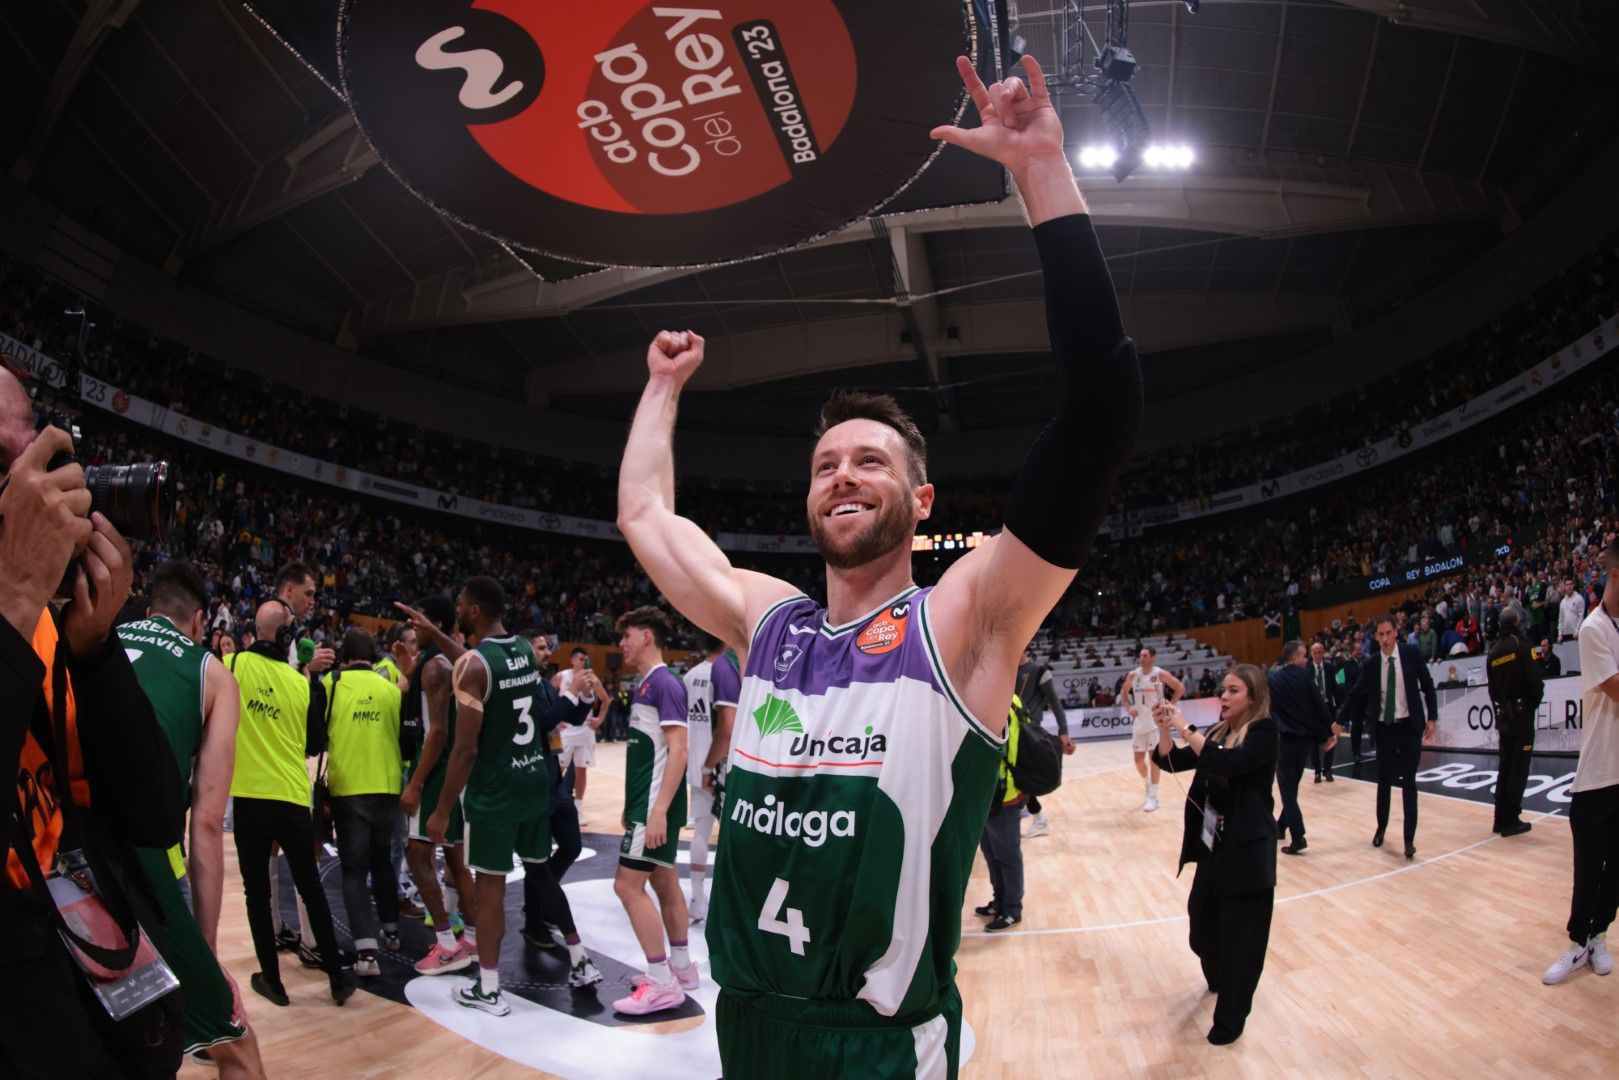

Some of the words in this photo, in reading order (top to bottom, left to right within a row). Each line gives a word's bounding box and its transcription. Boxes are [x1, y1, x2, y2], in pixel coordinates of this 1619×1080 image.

[652, 7, 742, 105] Rey
[577, 99, 637, 163] acb
[594, 42, 700, 176] Copa
[761, 60, 816, 163] Badalona
[693, 111, 741, 156] del
[1369, 577, 1391, 590] COPA
[1406, 568, 1420, 580] REY
[1424, 556, 1463, 576] BADALON
[866, 625, 896, 636] Copa
[506, 655, 529, 670] EJIM
[247, 699, 280, 721] MMCC
[353, 711, 381, 724] MMCC
[512, 696, 535, 746] 3
[1082, 716, 1133, 729] #Copa
[758, 877, 811, 956] 4
